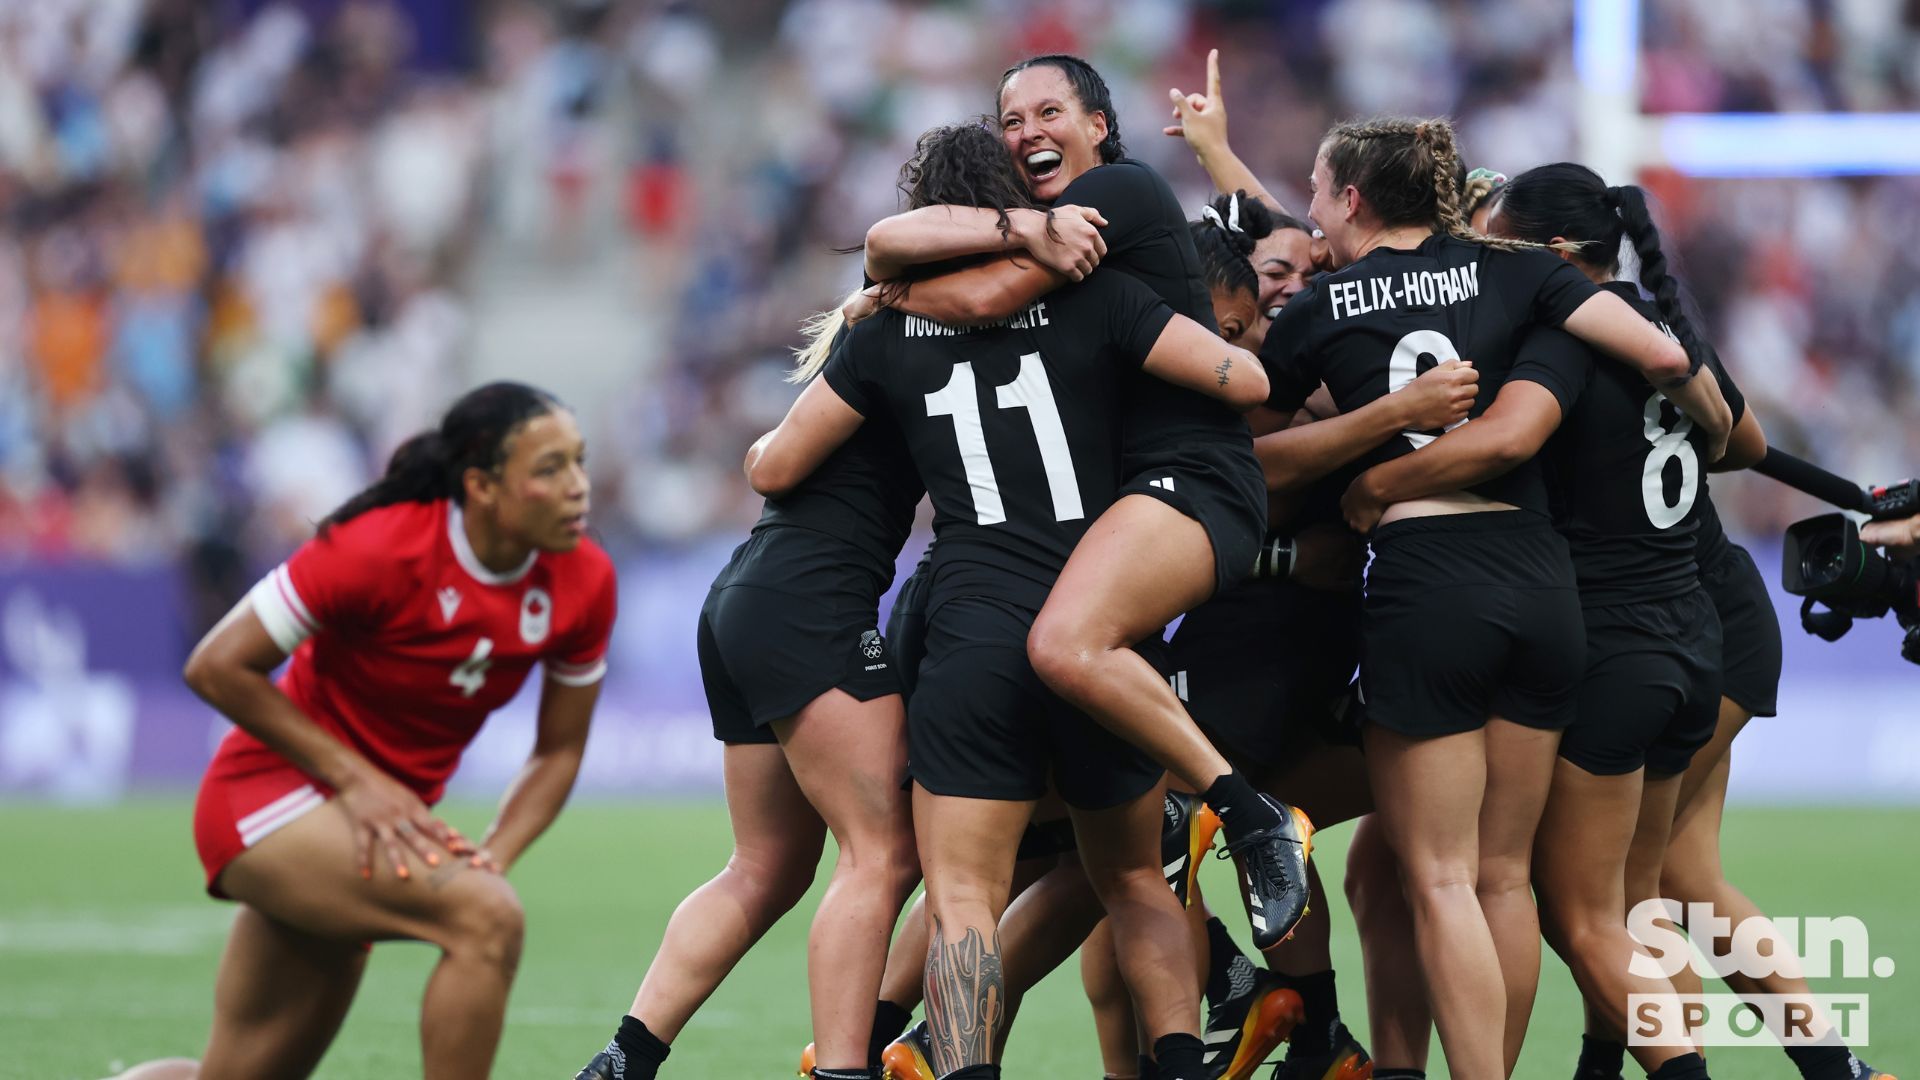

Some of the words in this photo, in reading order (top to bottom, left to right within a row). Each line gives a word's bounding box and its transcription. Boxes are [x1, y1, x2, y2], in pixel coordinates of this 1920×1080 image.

[1329, 261, 1479, 320] FELIX-HOTHAM
[924, 351, 1085, 526] 11
[1642, 392, 1699, 529] 8
[450, 637, 494, 698] 4
